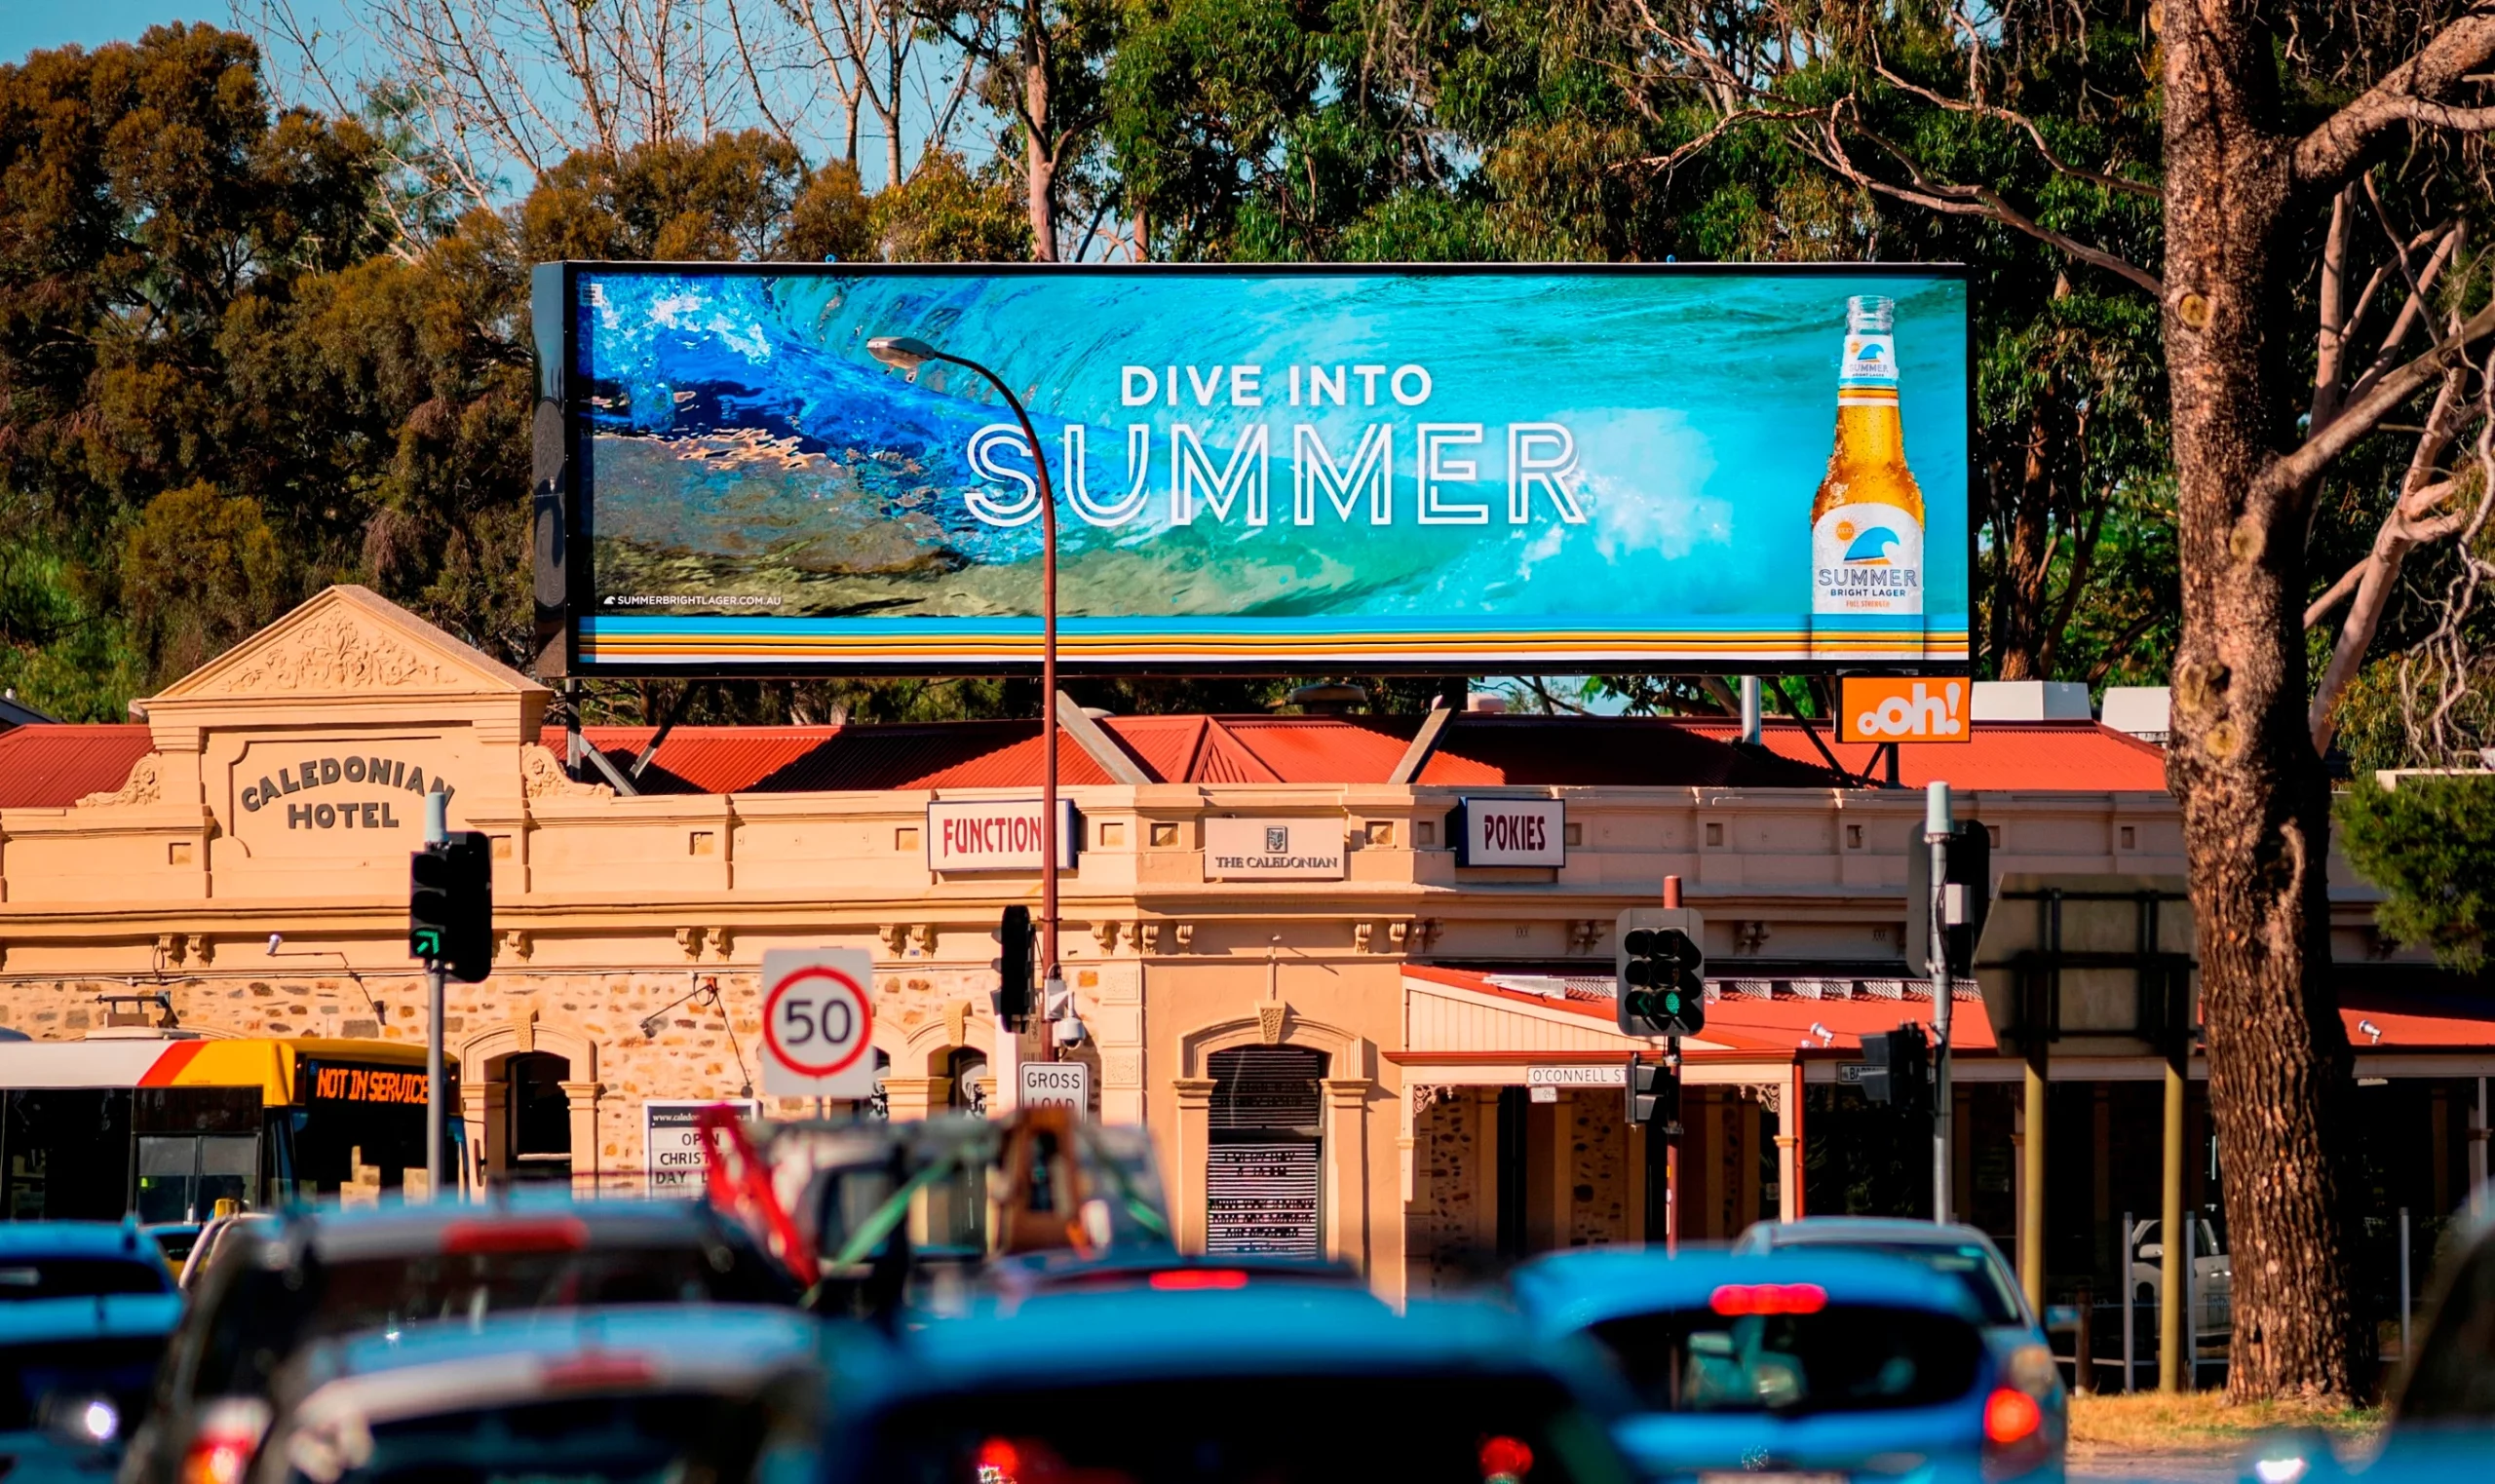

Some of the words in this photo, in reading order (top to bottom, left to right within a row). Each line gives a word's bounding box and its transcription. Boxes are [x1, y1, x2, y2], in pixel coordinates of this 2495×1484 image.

[1122, 365, 1261, 406] DIVE
[1290, 364, 1432, 406] INTO
[964, 422, 1588, 527] SUMMER
[1818, 568, 1918, 588] SUMMER
[617, 595, 782, 606] SUMMERBRIGHTLAGER.COM.AU
[1830, 589, 1868, 597] BRIGHT
[1872, 589, 1906, 597] LAGER
[288, 802, 400, 829] HOTEL
[1483, 814, 1547, 852] POKIES
[1215, 856, 1245, 869] THE
[1247, 856, 1338, 869] CALEDONIAN
[785, 998, 853, 1046] 50
[1027, 1072, 1081, 1089] GROSS
[1533, 1069, 1608, 1083] O'CONNELL
[317, 1068, 349, 1099] NOT
[348, 1070, 369, 1101] IN
[367, 1071, 430, 1104] SERVICE
[682, 1132, 720, 1147] OPN
[656, 1171, 688, 1186] DAY
